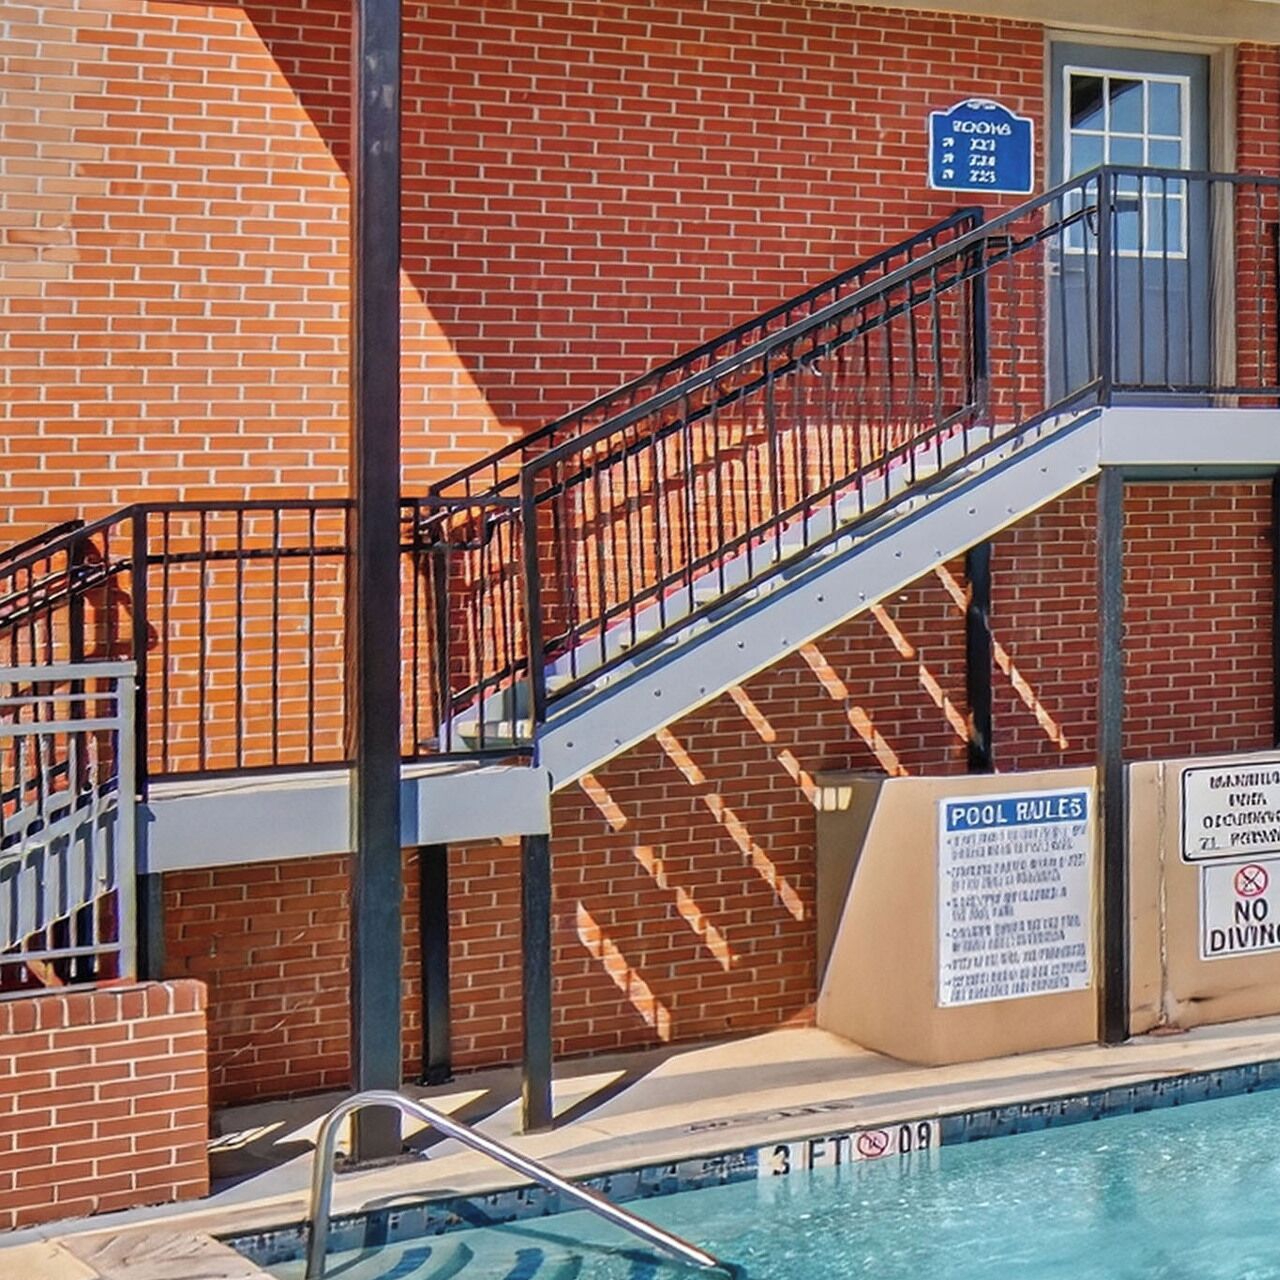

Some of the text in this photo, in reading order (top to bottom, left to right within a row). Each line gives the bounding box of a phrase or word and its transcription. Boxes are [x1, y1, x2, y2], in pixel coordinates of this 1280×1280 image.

[951, 797, 1083, 828] POOL RULES
[1234, 897, 1269, 925] NO
[772, 1144, 791, 1176] 3
[808, 1134, 850, 1170] FT
